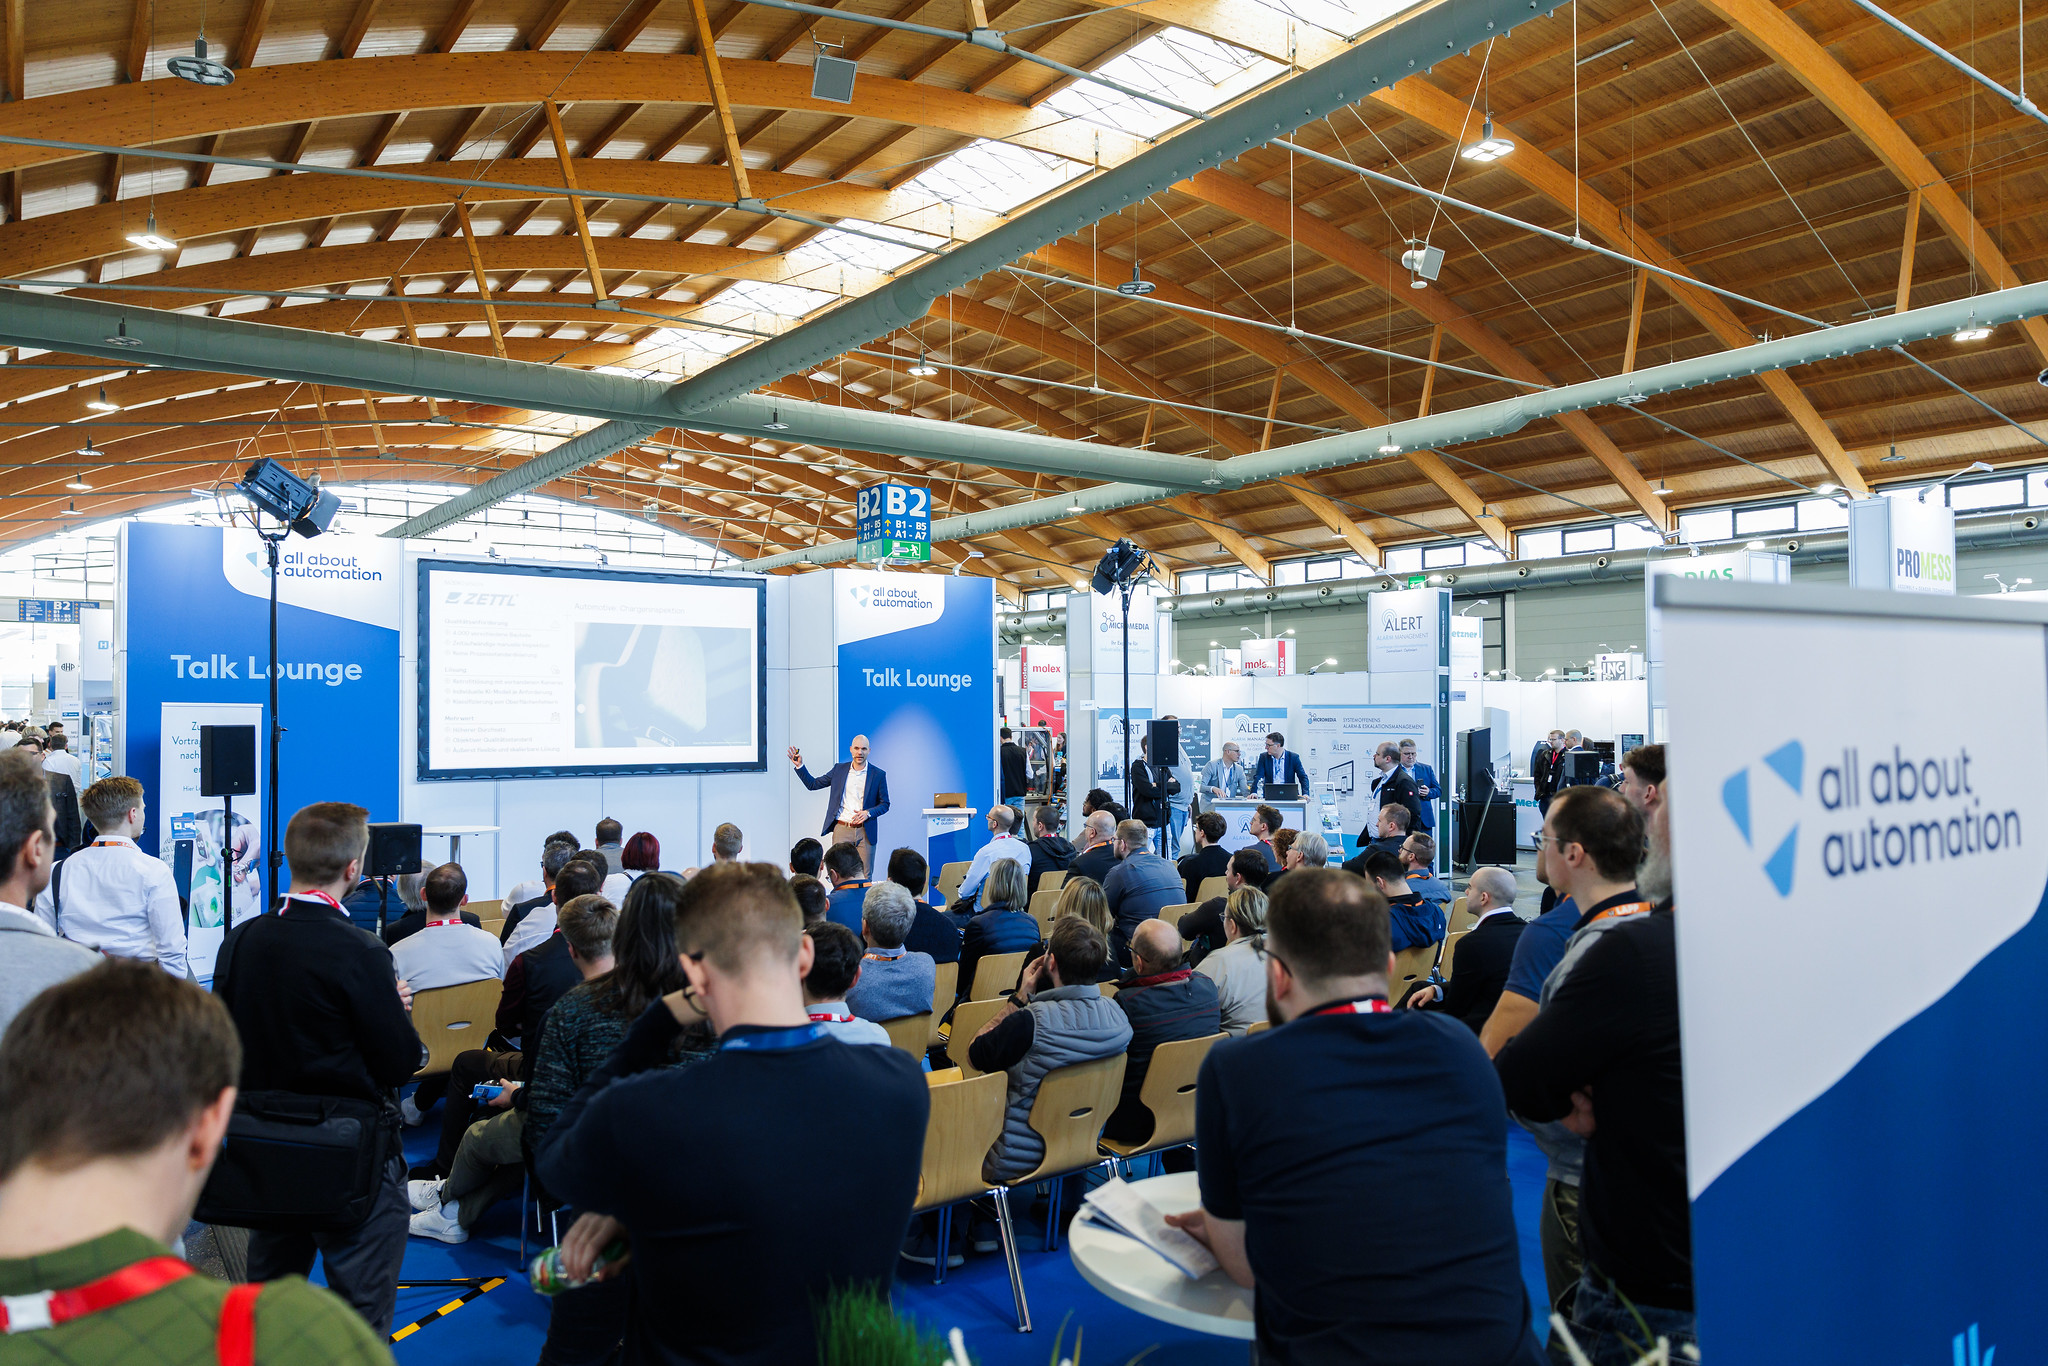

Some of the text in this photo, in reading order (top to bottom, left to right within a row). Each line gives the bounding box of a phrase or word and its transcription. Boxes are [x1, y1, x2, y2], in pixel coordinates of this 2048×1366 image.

[858, 487, 880, 519] B2
[886, 486, 926, 518] B2
[863, 523, 870, 531] B1
[874, 519, 881, 528] B5
[895, 520, 906, 529] B1
[916, 521, 927, 531] B5
[863, 533, 870, 541] A1
[873, 529, 881, 538] A7
[895, 530, 906, 539] A1
[915, 530, 926, 540] A7
[284, 552, 357, 567] all about
[1897, 547, 1951, 582] PROMESS
[284, 566, 382, 581] automation
[873, 587, 918, 599] all about
[464, 593, 515, 606] ZETTL
[873, 598, 933, 609] automation
[53, 601, 71, 611] B2
[1109, 622, 1150, 630] MICRMEDIA
[1384, 616, 1423, 631] ALERT
[1452, 630, 1478, 638] etzner
[170, 654, 363, 687] Talk Lounge
[1033, 664, 1061, 673] molex
[862, 668, 972, 692] Talk Lounge
[1112, 723, 1141, 735] ALRT
[1238, 722, 1273, 733] ALERT
[172, 735, 201, 748] Vortra
[1332, 743, 1350, 751] ALERT
[180, 750, 200, 760] nach
[1820, 744, 1973, 812] all about
[1515, 799, 1540, 808] Met
[1823, 799, 2023, 878] automation
[1615, 903, 1640, 916] LAPP
